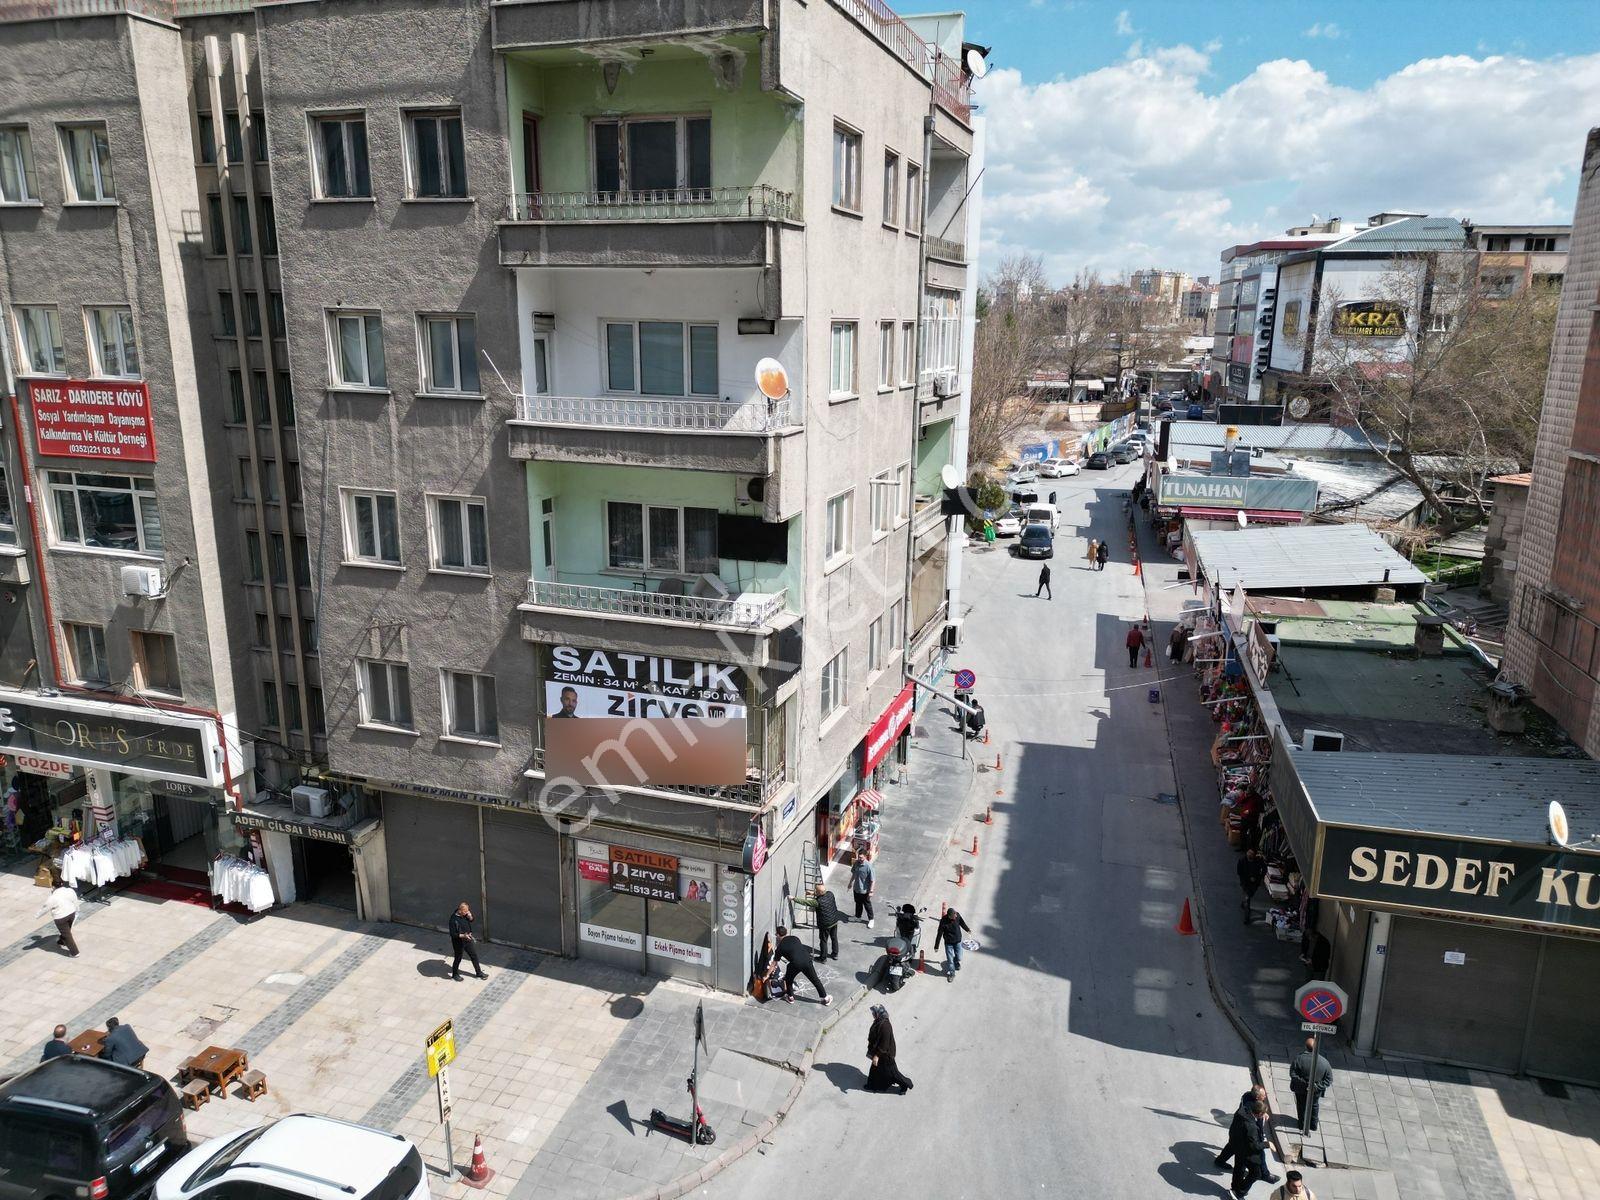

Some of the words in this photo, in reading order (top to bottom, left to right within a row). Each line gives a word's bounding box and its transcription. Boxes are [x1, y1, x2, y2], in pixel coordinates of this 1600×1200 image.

[34, 388, 62, 403] SARIZ
[68, 389, 115, 405] DARIDERE
[116, 389, 143, 407] KÖYÜ
[37, 409, 60, 424] Sosyal
[63, 410, 105, 426] Yardımlaşma
[108, 412, 146, 429] Dayanışma
[39, 427, 82, 441] Kalkındırma
[83, 430, 93, 442] Ve
[94, 430, 116, 443] Kültür
[118, 431, 148, 448] Derneği
[102, 446, 111, 455] 03
[112, 446, 121, 455] 04
[1164, 482, 1244, 498] TUNAHAN
[552, 646, 740, 692] SATILIK
[553, 671, 595, 685] ZEMİN
[603, 678, 620, 687] 34
[662, 686, 689, 697] KAT
[698, 690, 719, 701] 150
[607, 691, 705, 718] zirve
[235, 815, 265, 828] ADEM
[307, 826, 347, 842] İŞHANI
[615, 850, 673, 869] SATILIK
[1348, 847, 1515, 898] SEDEF
[1536, 867, 1600, 911] KU
[633, 885, 650, 895] 513
[651, 888, 662, 898] 21
[664, 891, 675, 900] 21
[654, 941, 668, 952] Erkek
